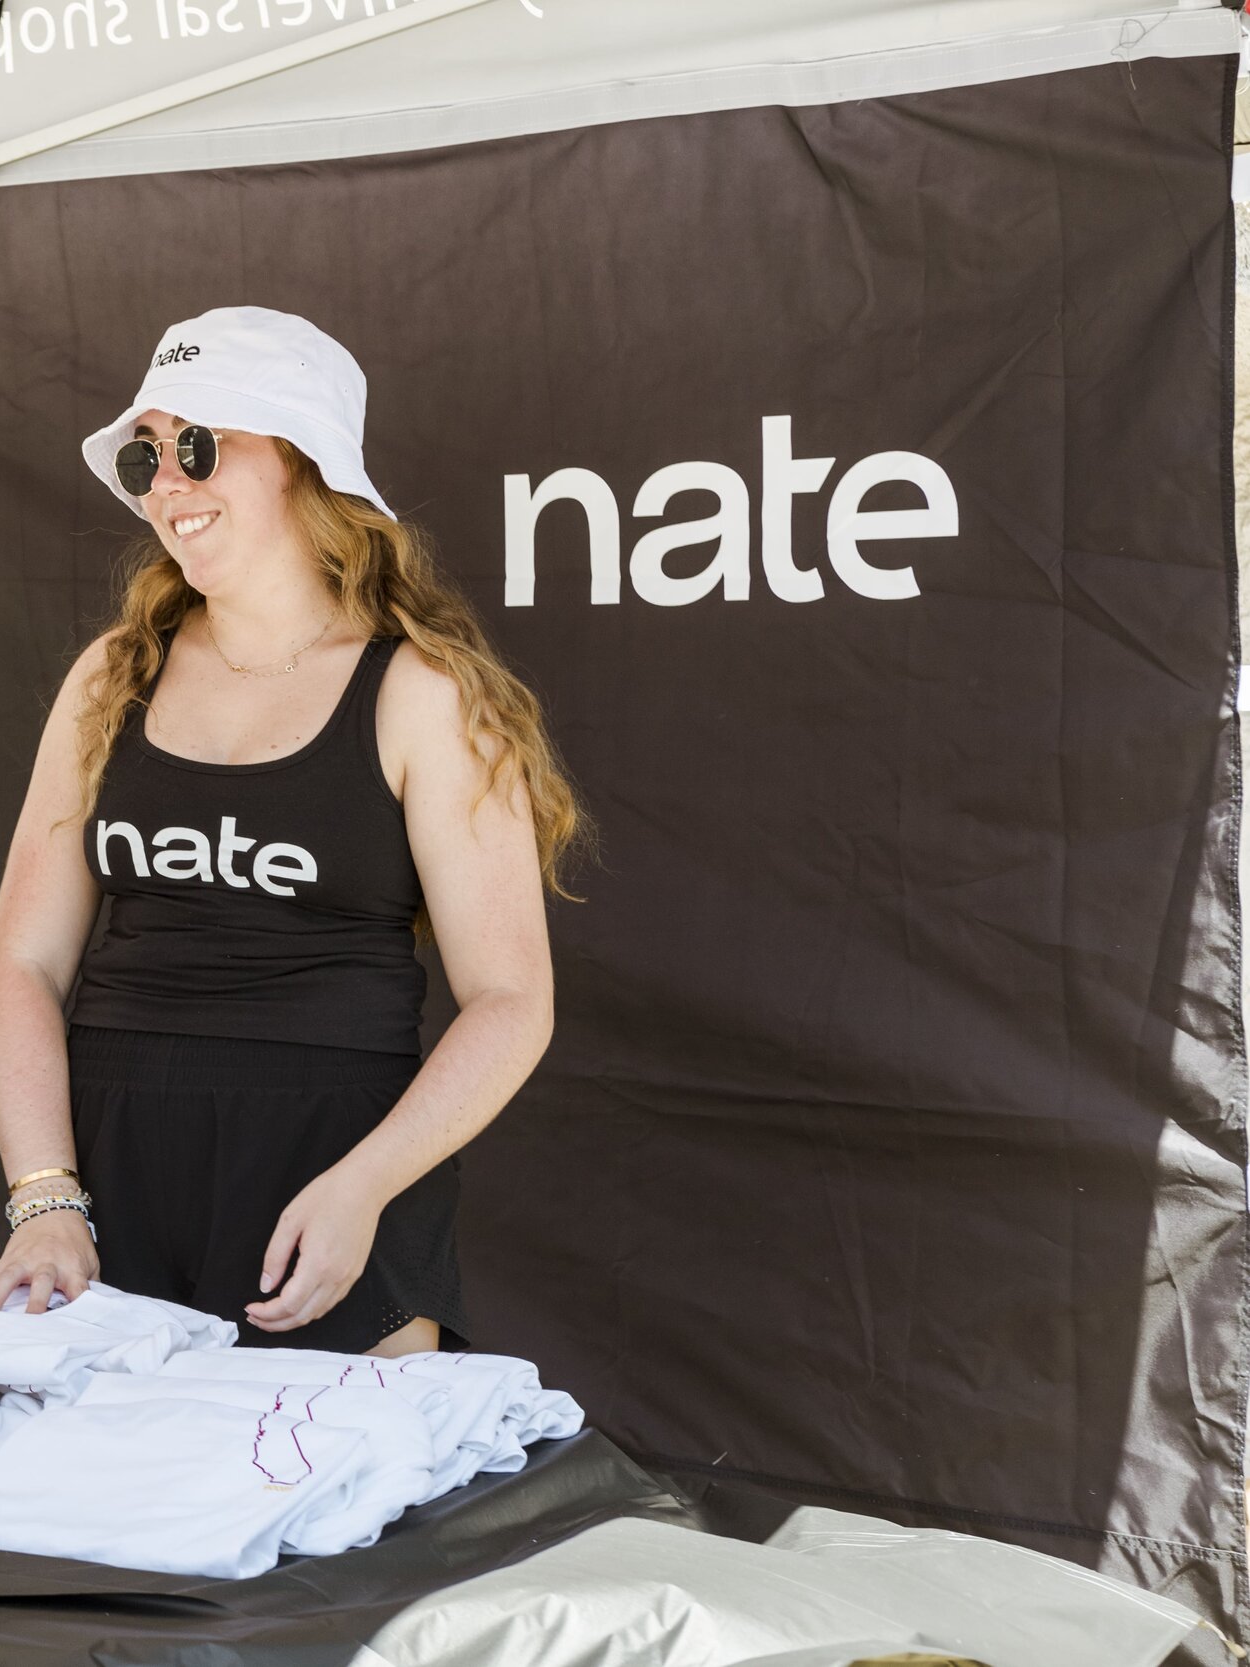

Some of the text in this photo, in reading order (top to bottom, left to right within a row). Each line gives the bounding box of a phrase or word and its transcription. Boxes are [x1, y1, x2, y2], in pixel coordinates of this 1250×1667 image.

[150, 342, 200, 370] nate
[504, 414, 959, 607] nate
[97, 816, 318, 896] nate
